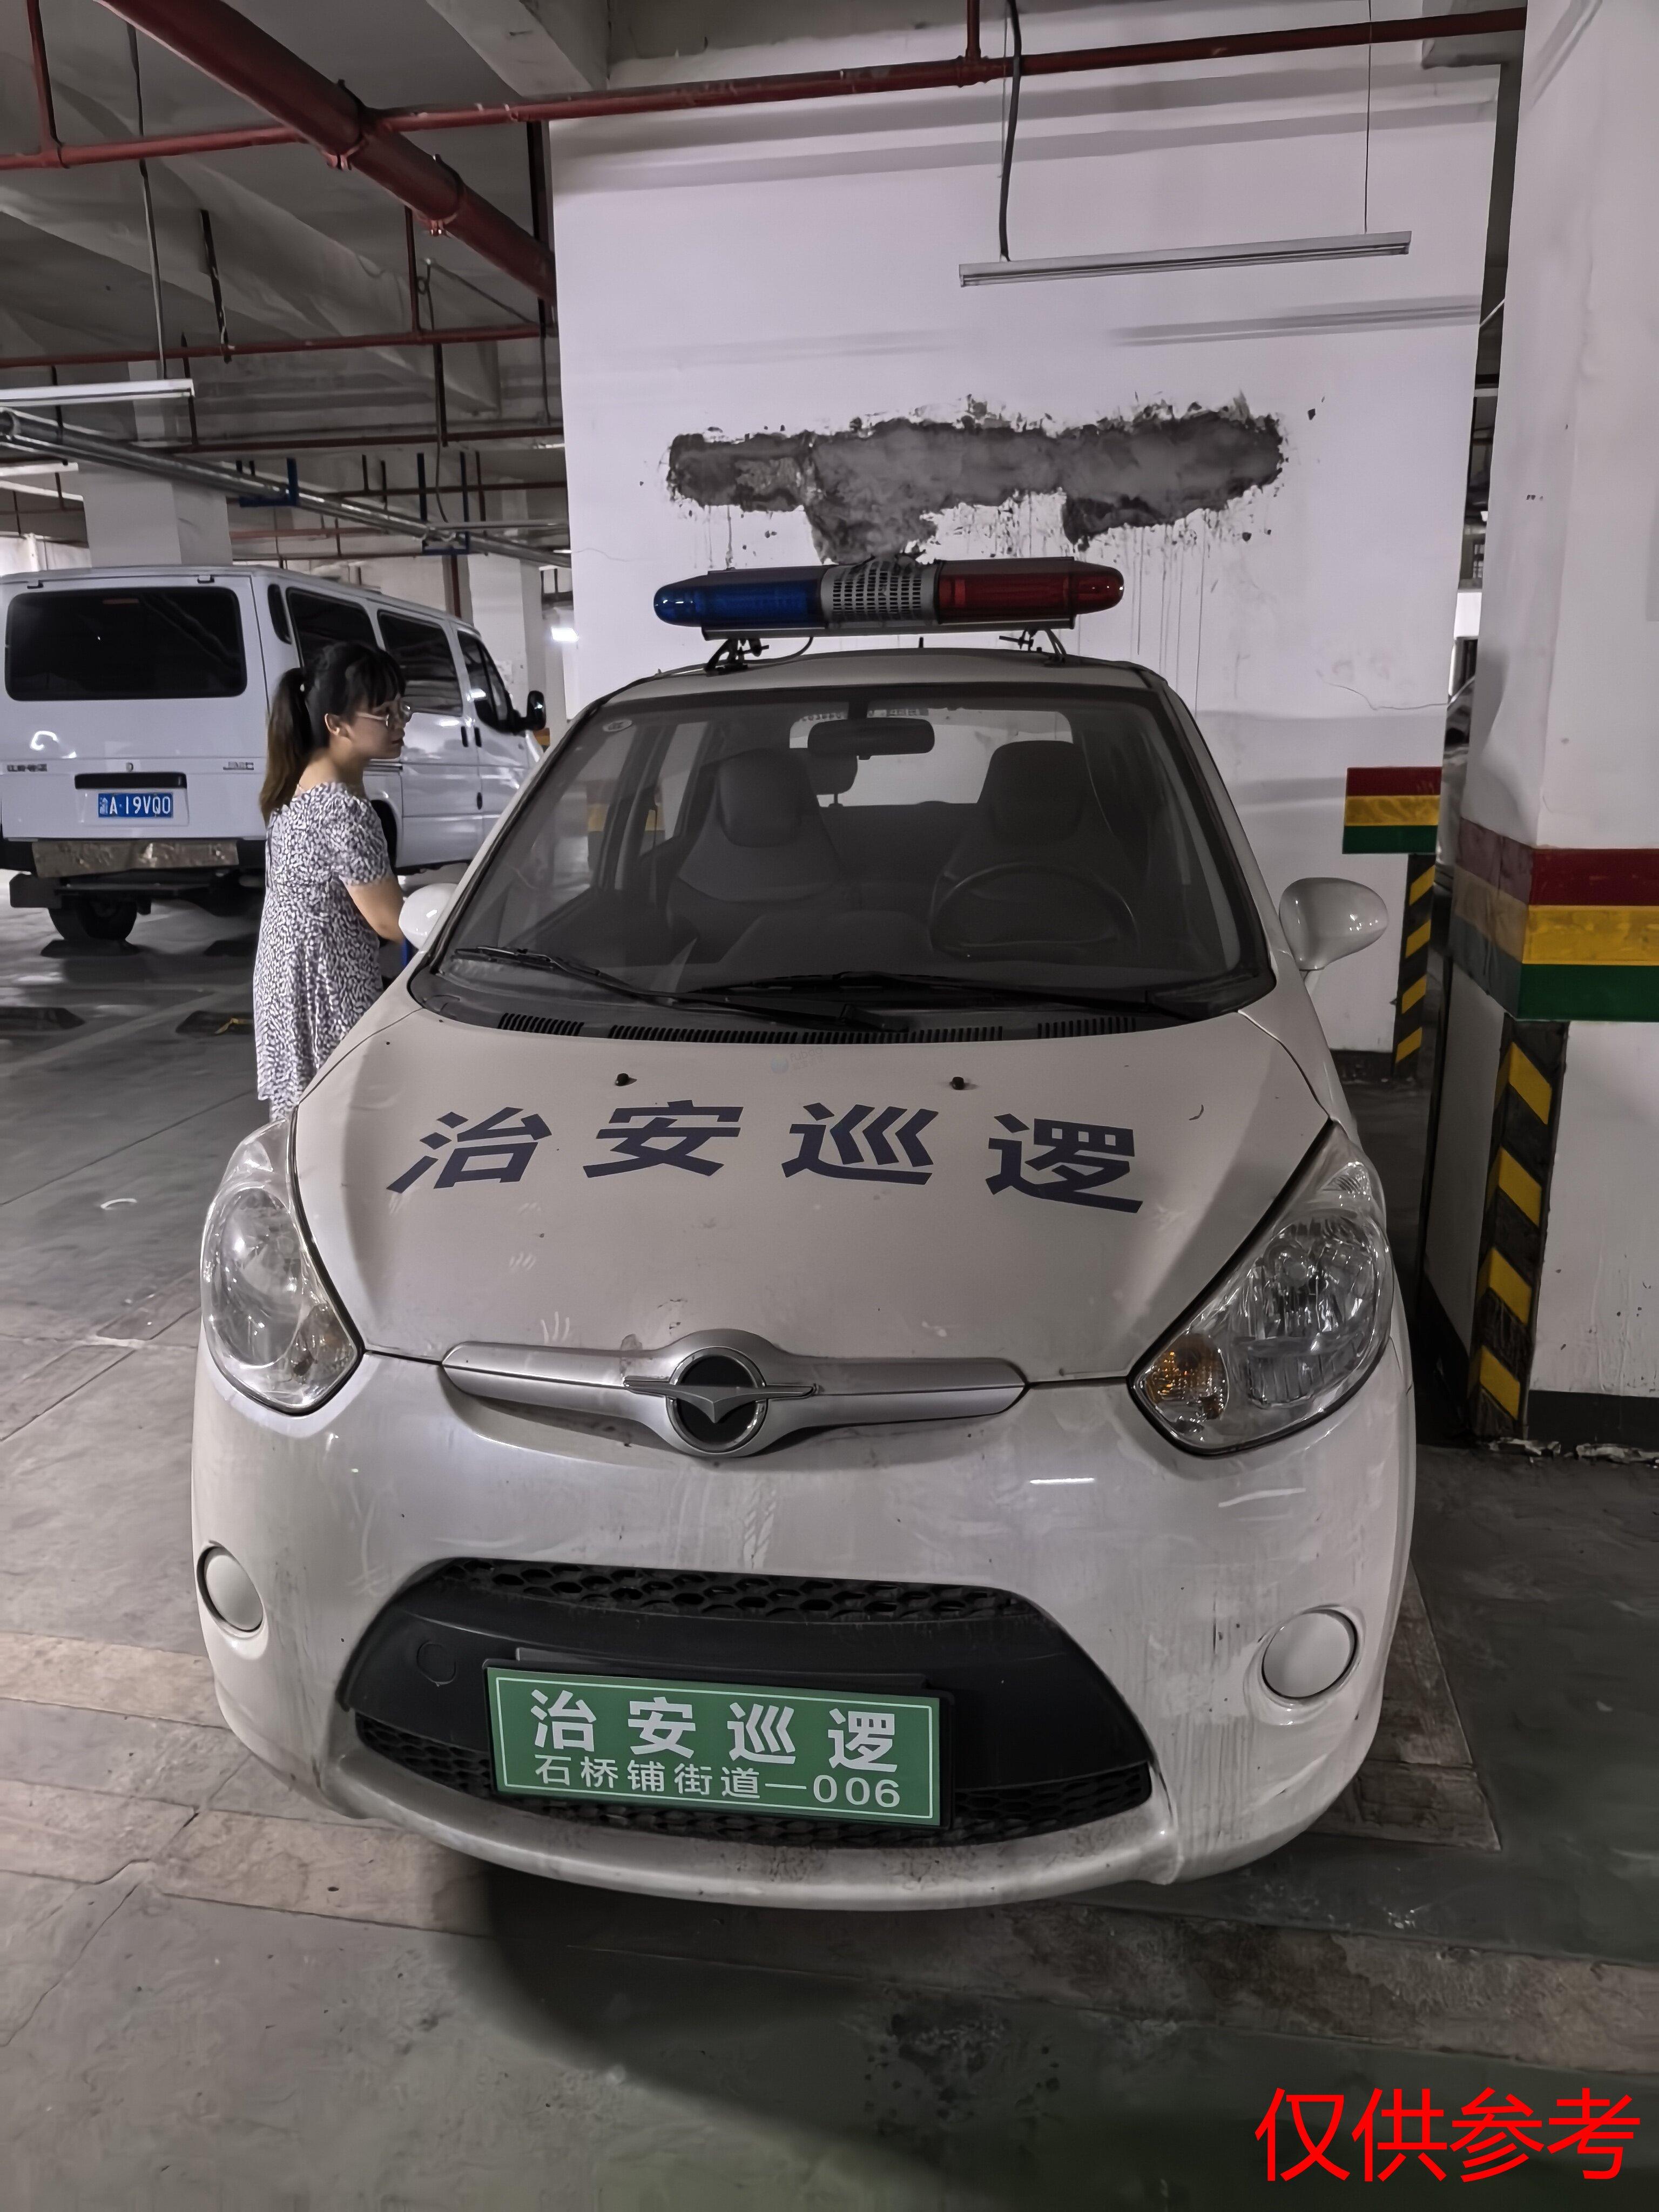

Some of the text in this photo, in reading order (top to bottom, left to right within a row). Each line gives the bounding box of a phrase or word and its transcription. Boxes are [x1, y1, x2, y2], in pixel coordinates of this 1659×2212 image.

[387, 1100, 1143, 1213] 治安巡逻
[531, 1689, 898, 1772] 治安巡逻
